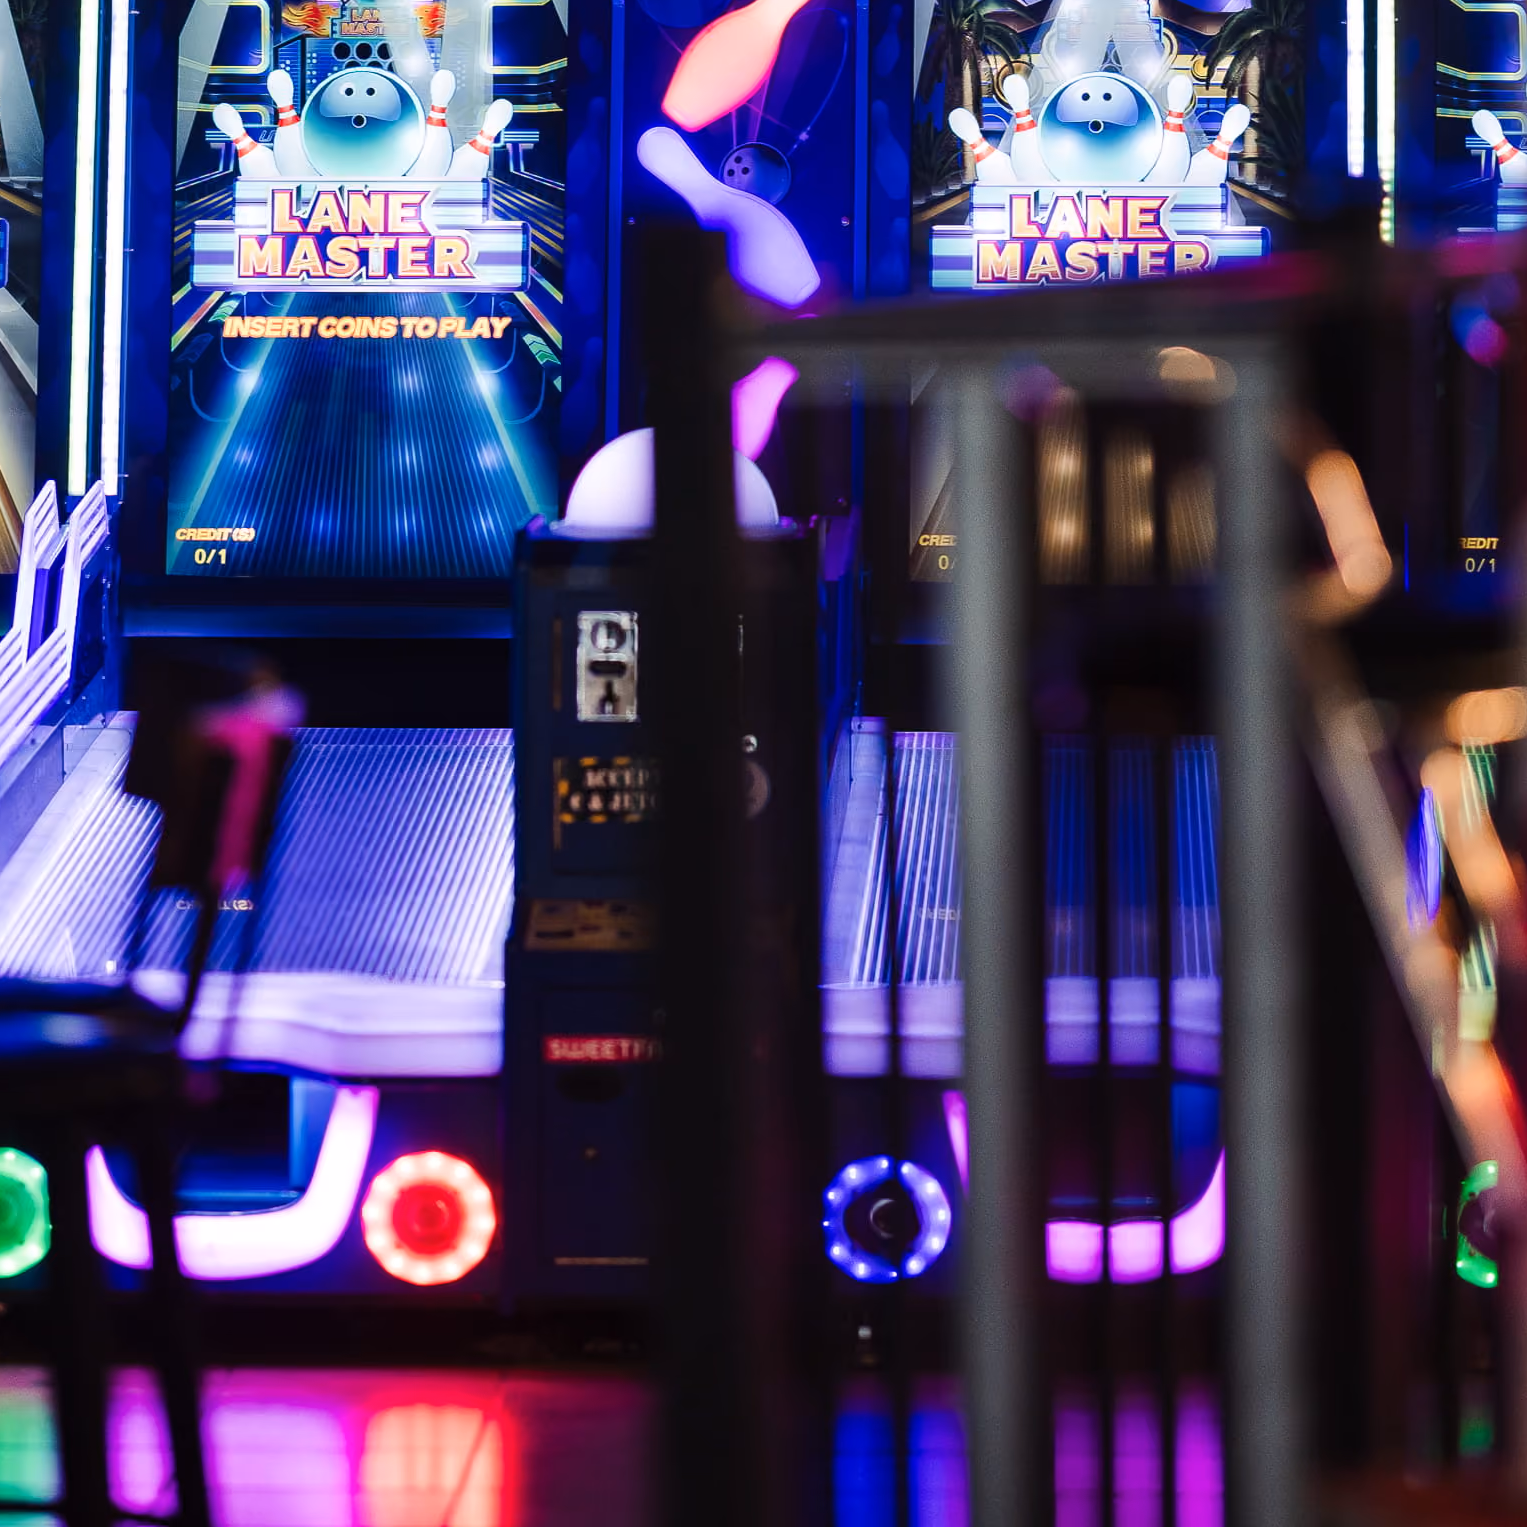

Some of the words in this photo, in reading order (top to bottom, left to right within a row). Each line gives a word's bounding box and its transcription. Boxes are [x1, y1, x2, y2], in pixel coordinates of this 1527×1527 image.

[341, 22, 384, 35] MAST
[272, 190, 431, 233] LANE
[1010, 194, 1169, 238] LANE
[238, 235, 476, 278] MASTER
[978, 241, 1211, 281] MASTER
[223, 316, 318, 338] INSERT
[318, 316, 398, 338] COINS
[400, 317, 438, 338] TO
[437, 317, 511, 339] PLAY
[195, 549, 226, 564] 0/1
[1465, 557, 1495, 573] 0/1
